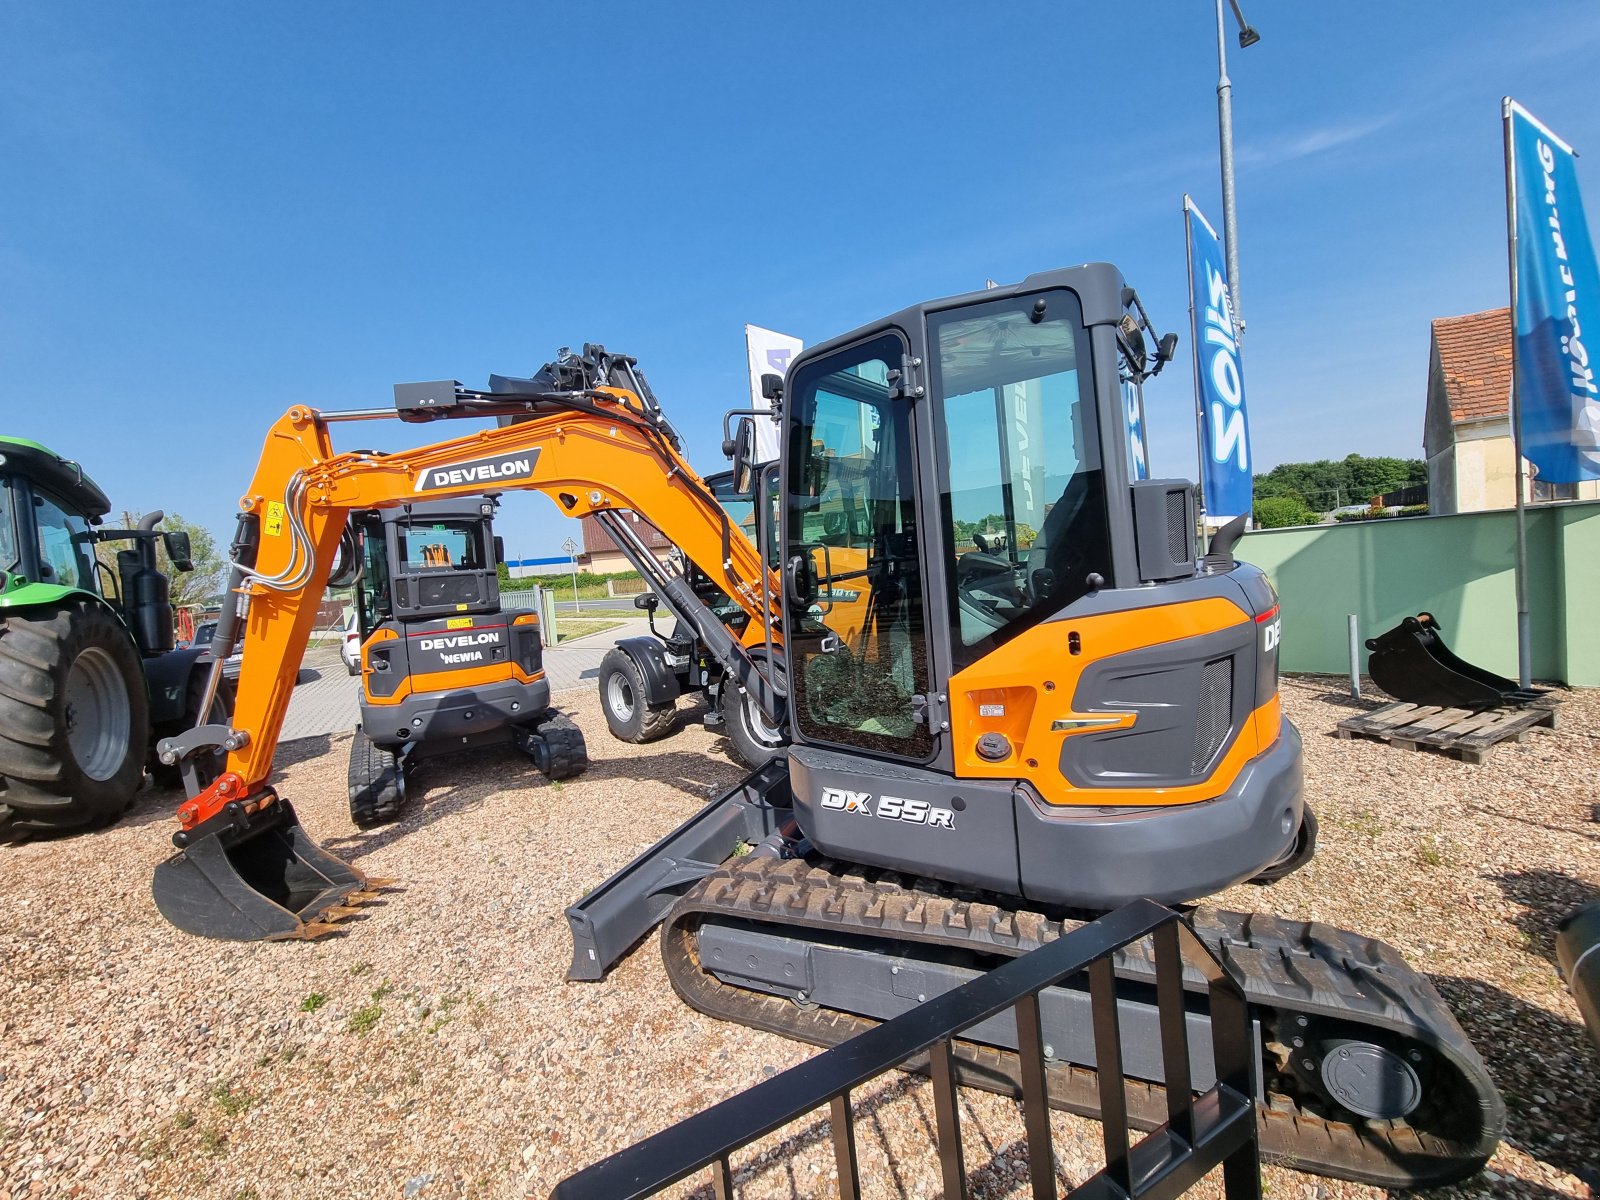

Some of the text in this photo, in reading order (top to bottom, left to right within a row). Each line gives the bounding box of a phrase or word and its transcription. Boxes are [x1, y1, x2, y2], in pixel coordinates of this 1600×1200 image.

[434, 460, 530, 486] DEVELON
[421, 632, 499, 651] DEVELON
[443, 651, 482, 664] NEWIA
[821, 787, 955, 830] DX 55R
